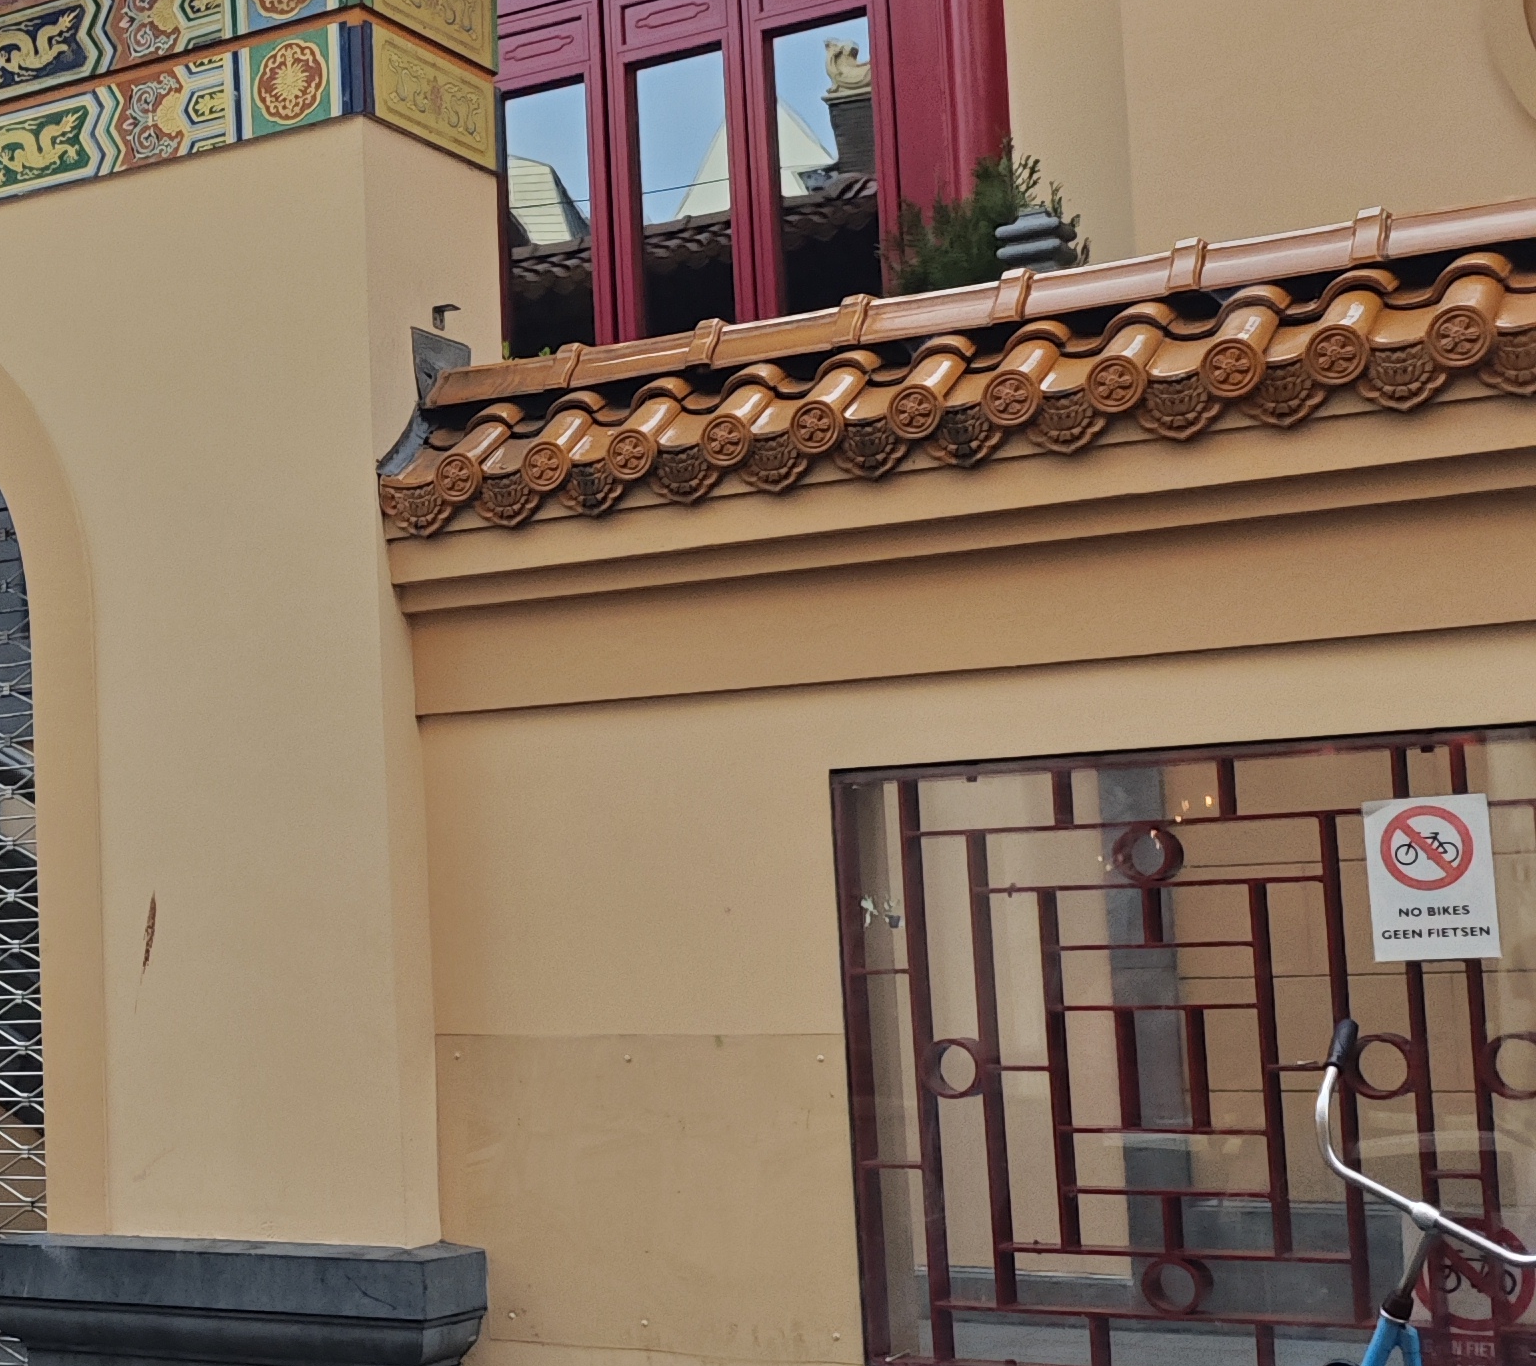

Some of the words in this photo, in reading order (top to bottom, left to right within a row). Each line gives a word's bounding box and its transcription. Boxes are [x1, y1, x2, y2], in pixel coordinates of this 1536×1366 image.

[1398, 907, 1422, 918] NO
[1427, 905, 1470, 917] BIKES
[1381, 928, 1423, 940] GEEN
[1428, 926, 1491, 938] FIETSEN
